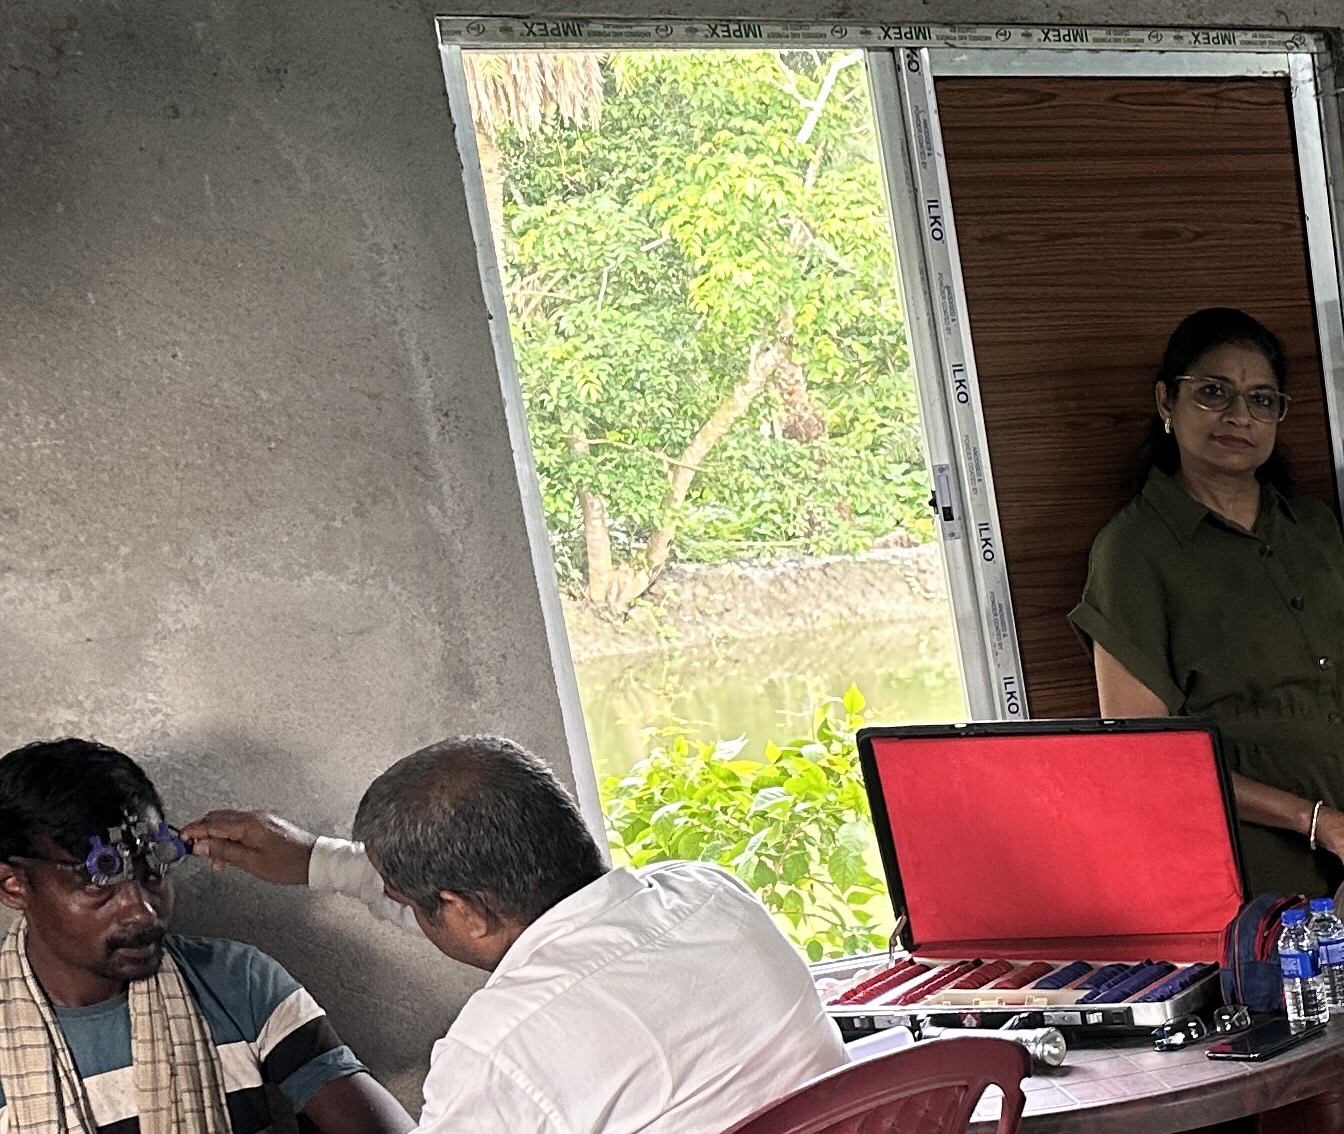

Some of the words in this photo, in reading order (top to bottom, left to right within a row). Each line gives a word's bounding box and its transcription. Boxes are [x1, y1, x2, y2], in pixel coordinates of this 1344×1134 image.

[525, 21, 583, 37] IMPEX
[708, 23, 763, 39] IMPEX
[881, 26, 932, 41] IMPEX
[1041, 28, 1089, 43] IMPEX
[1193, 31, 1237, 46] IMPEX
[926, 199, 944, 242] ILKO
[952, 363, 969, 404] ILKO
[978, 522, 995, 562] ILKO
[1003, 676, 1020, 715] ILKO
